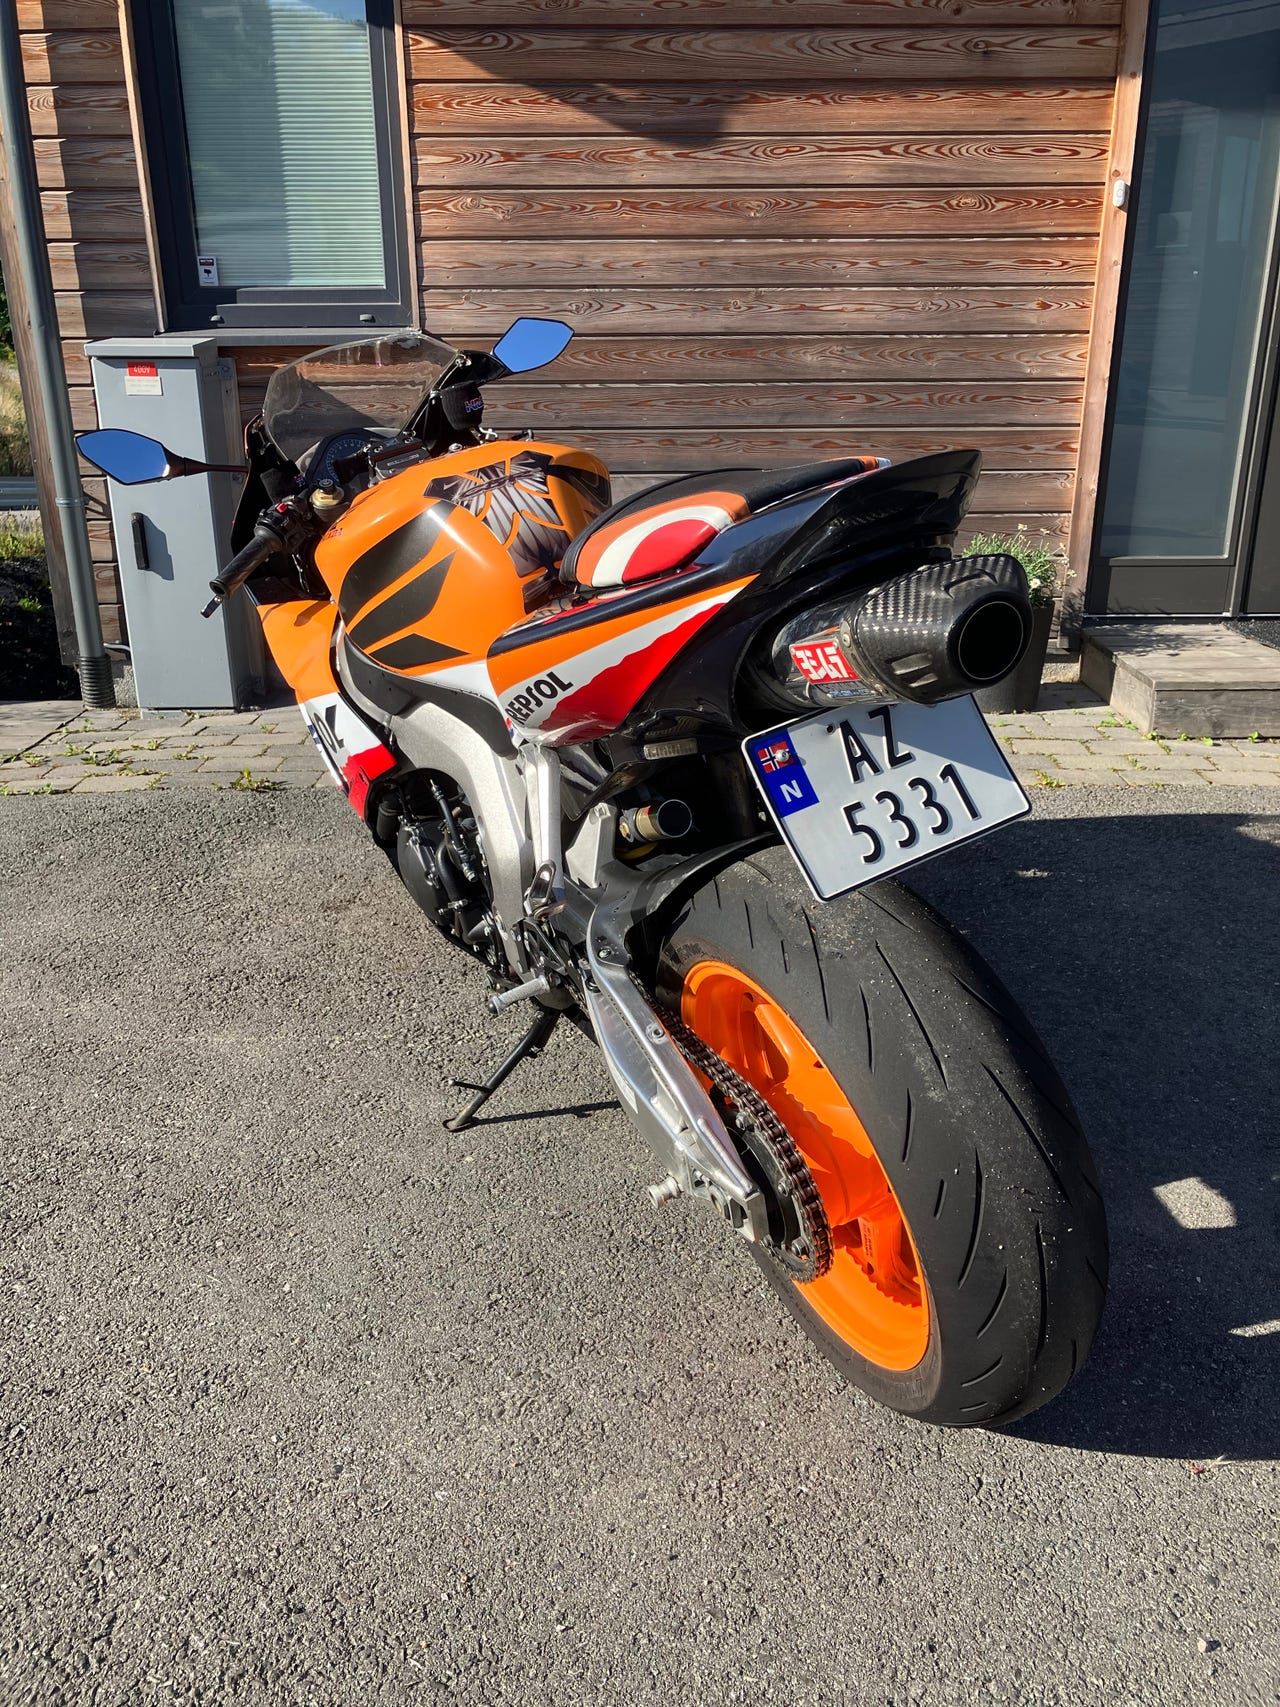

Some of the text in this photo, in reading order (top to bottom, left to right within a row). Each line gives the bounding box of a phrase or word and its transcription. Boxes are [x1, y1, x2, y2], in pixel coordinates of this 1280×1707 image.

[133, 365, 151, 374] 400V
[504, 671, 574, 725] REPSOL
[839, 705, 915, 783] AZ
[780, 779, 803, 803] N
[842, 764, 981, 864] 5331
